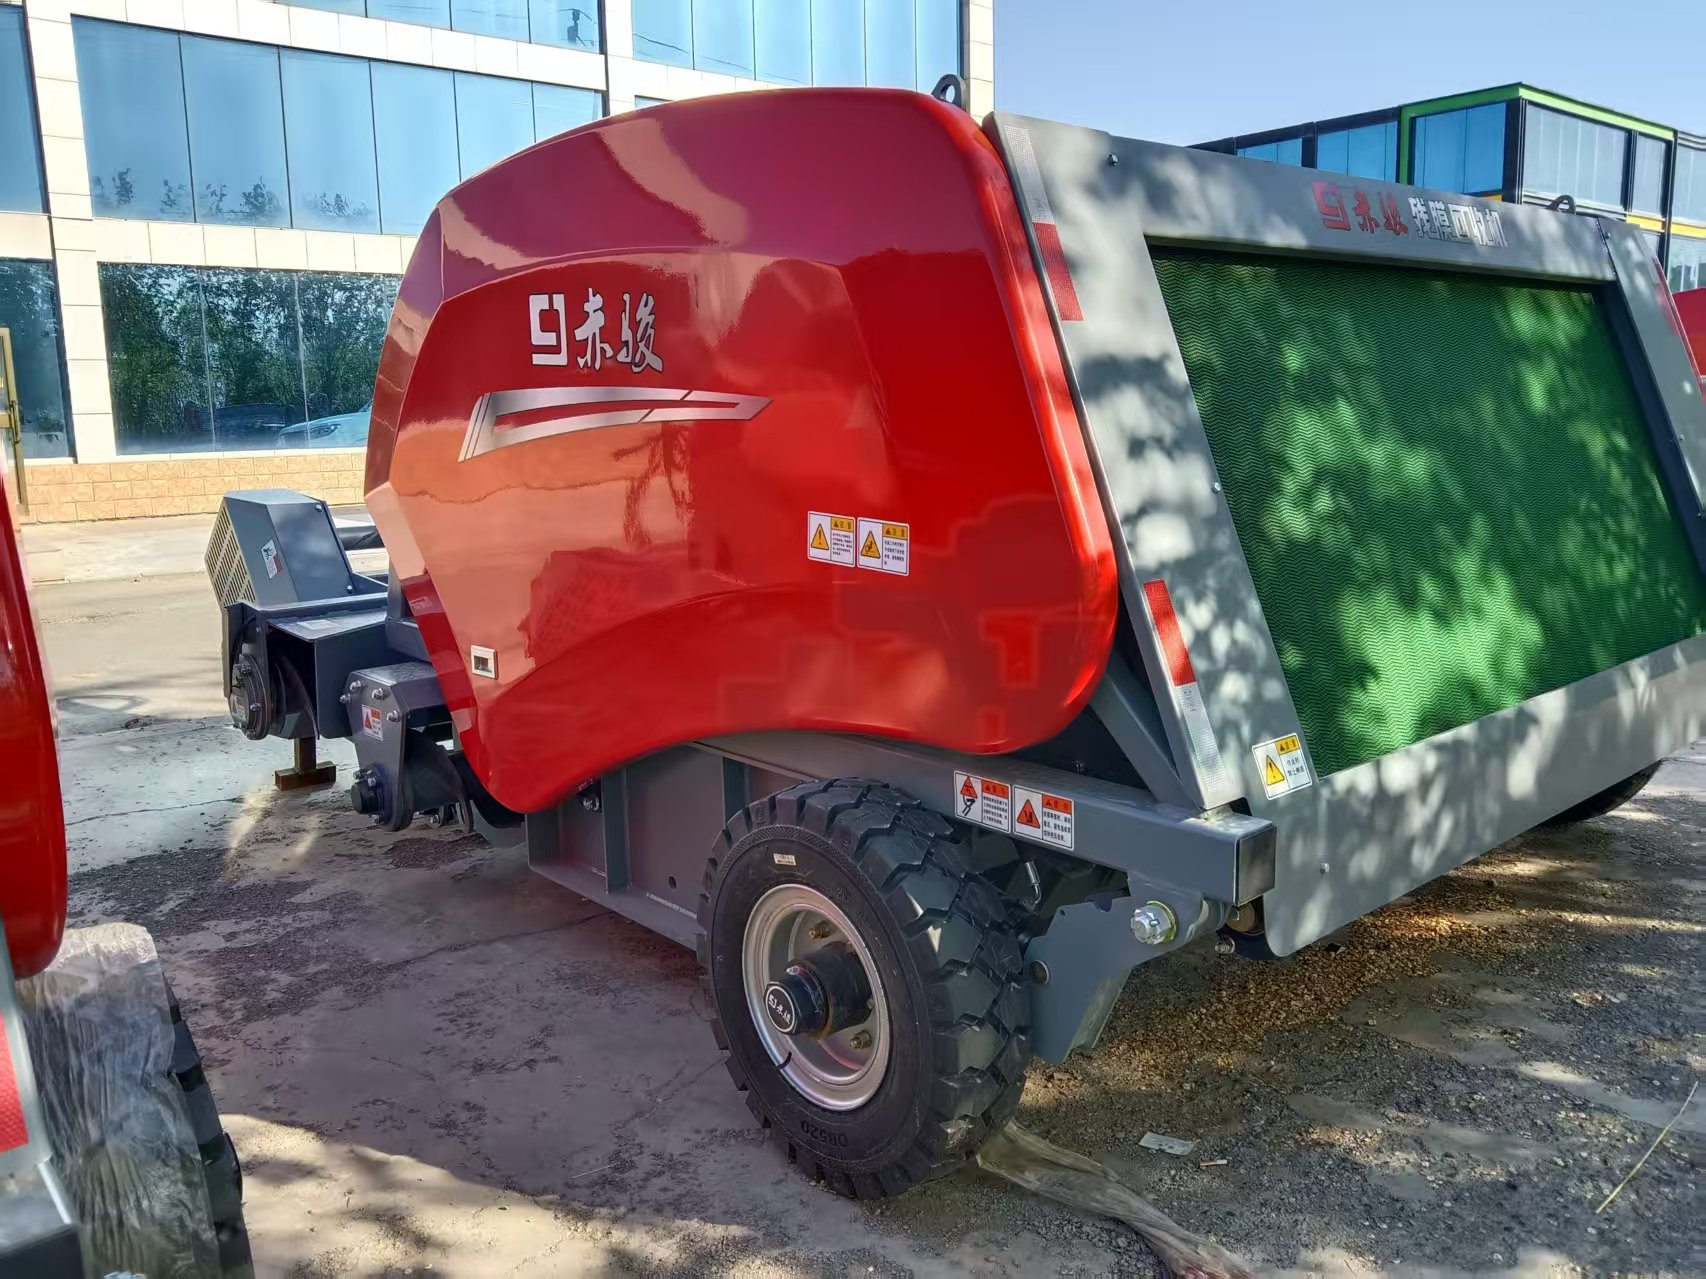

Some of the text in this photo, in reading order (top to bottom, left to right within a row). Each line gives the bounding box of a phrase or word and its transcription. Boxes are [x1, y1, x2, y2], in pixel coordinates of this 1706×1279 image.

[1408, 197, 1509, 248] 残膜回收机
[574, 287, 664, 373] 赤骏
